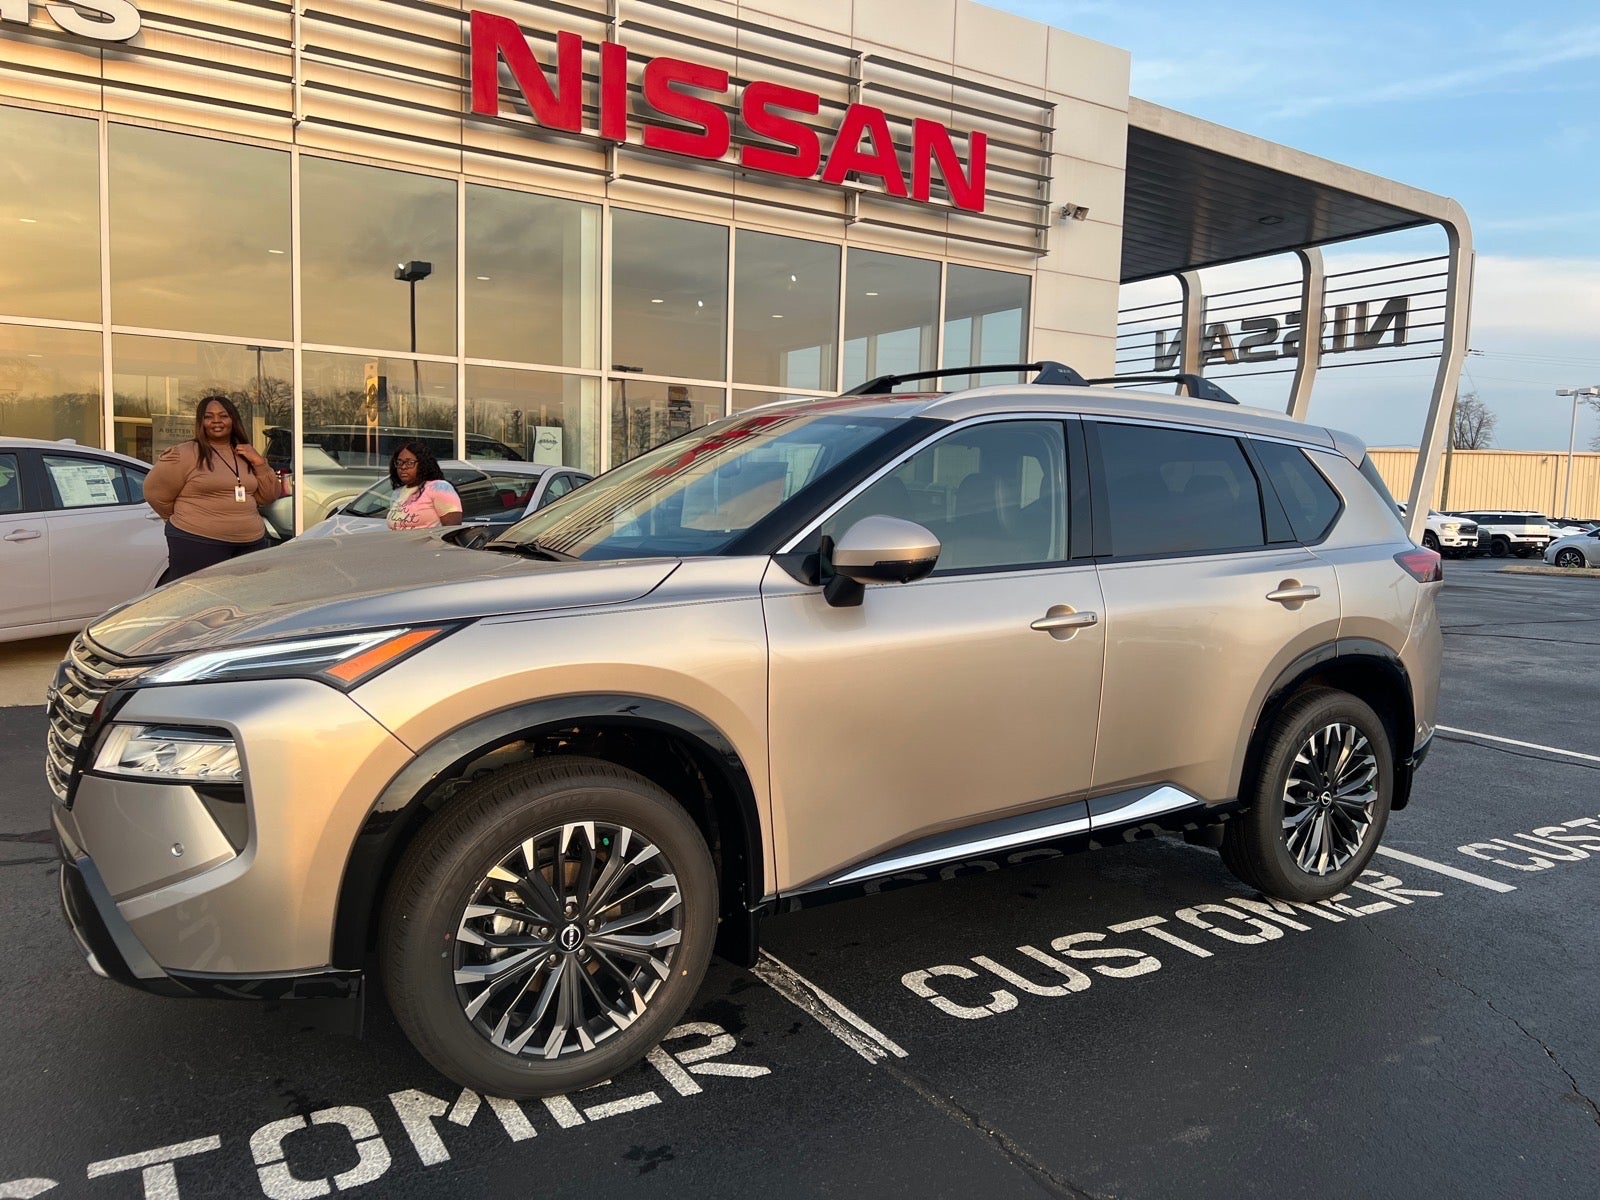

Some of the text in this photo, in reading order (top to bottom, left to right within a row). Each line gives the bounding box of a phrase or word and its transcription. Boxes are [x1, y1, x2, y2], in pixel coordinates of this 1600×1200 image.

[471, 11, 986, 212] NISSAN
[1457, 814, 1600, 871] CUST
[901, 870, 1444, 1019] CUSTOMER
